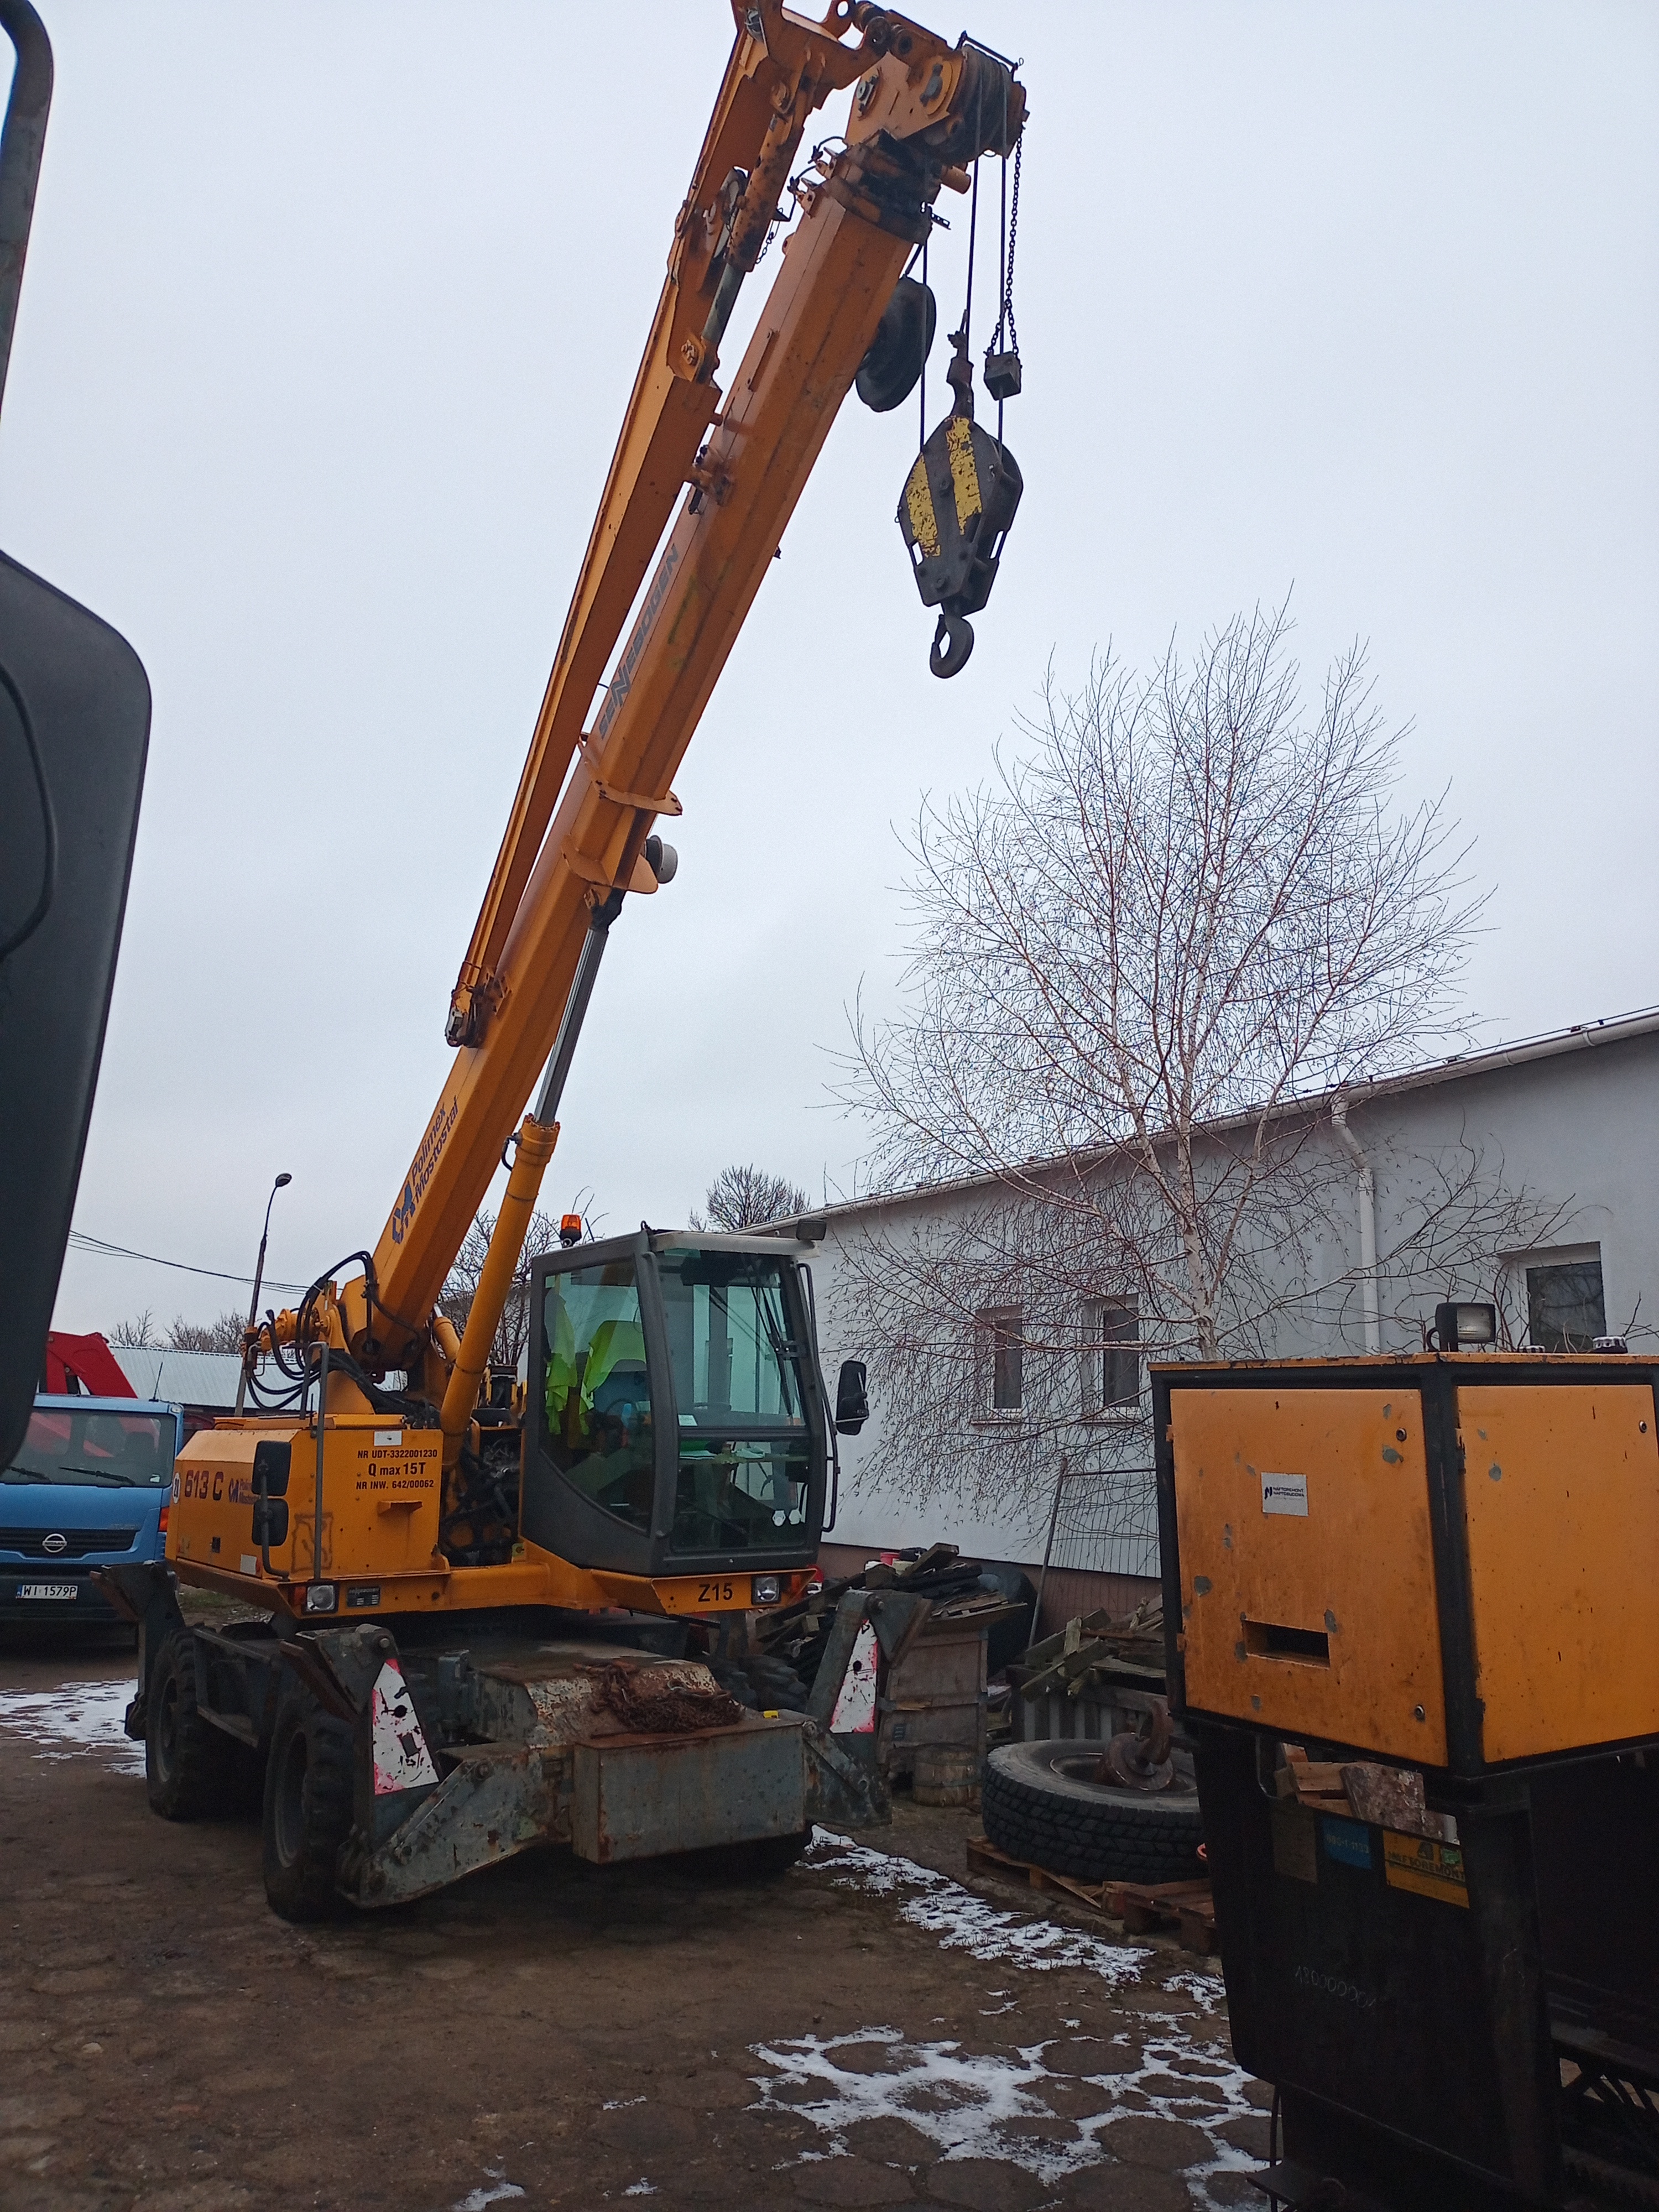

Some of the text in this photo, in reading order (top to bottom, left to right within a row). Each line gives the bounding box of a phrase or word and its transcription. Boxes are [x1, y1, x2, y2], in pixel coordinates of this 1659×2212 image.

[411, 1103, 446, 1187] Polimex
[414, 1095, 459, 1203] Mostostal
[357, 1449, 437, 1458] NR UDT-3322001230
[368, 1462, 426, 1477] Q max 15T
[184, 1469, 224, 1501] 613 C
[356, 1479, 434, 1489] NR INW. 642/00062
[23, 1585, 77, 1597] WI 1579P
[698, 1582, 733, 1602] Z15
